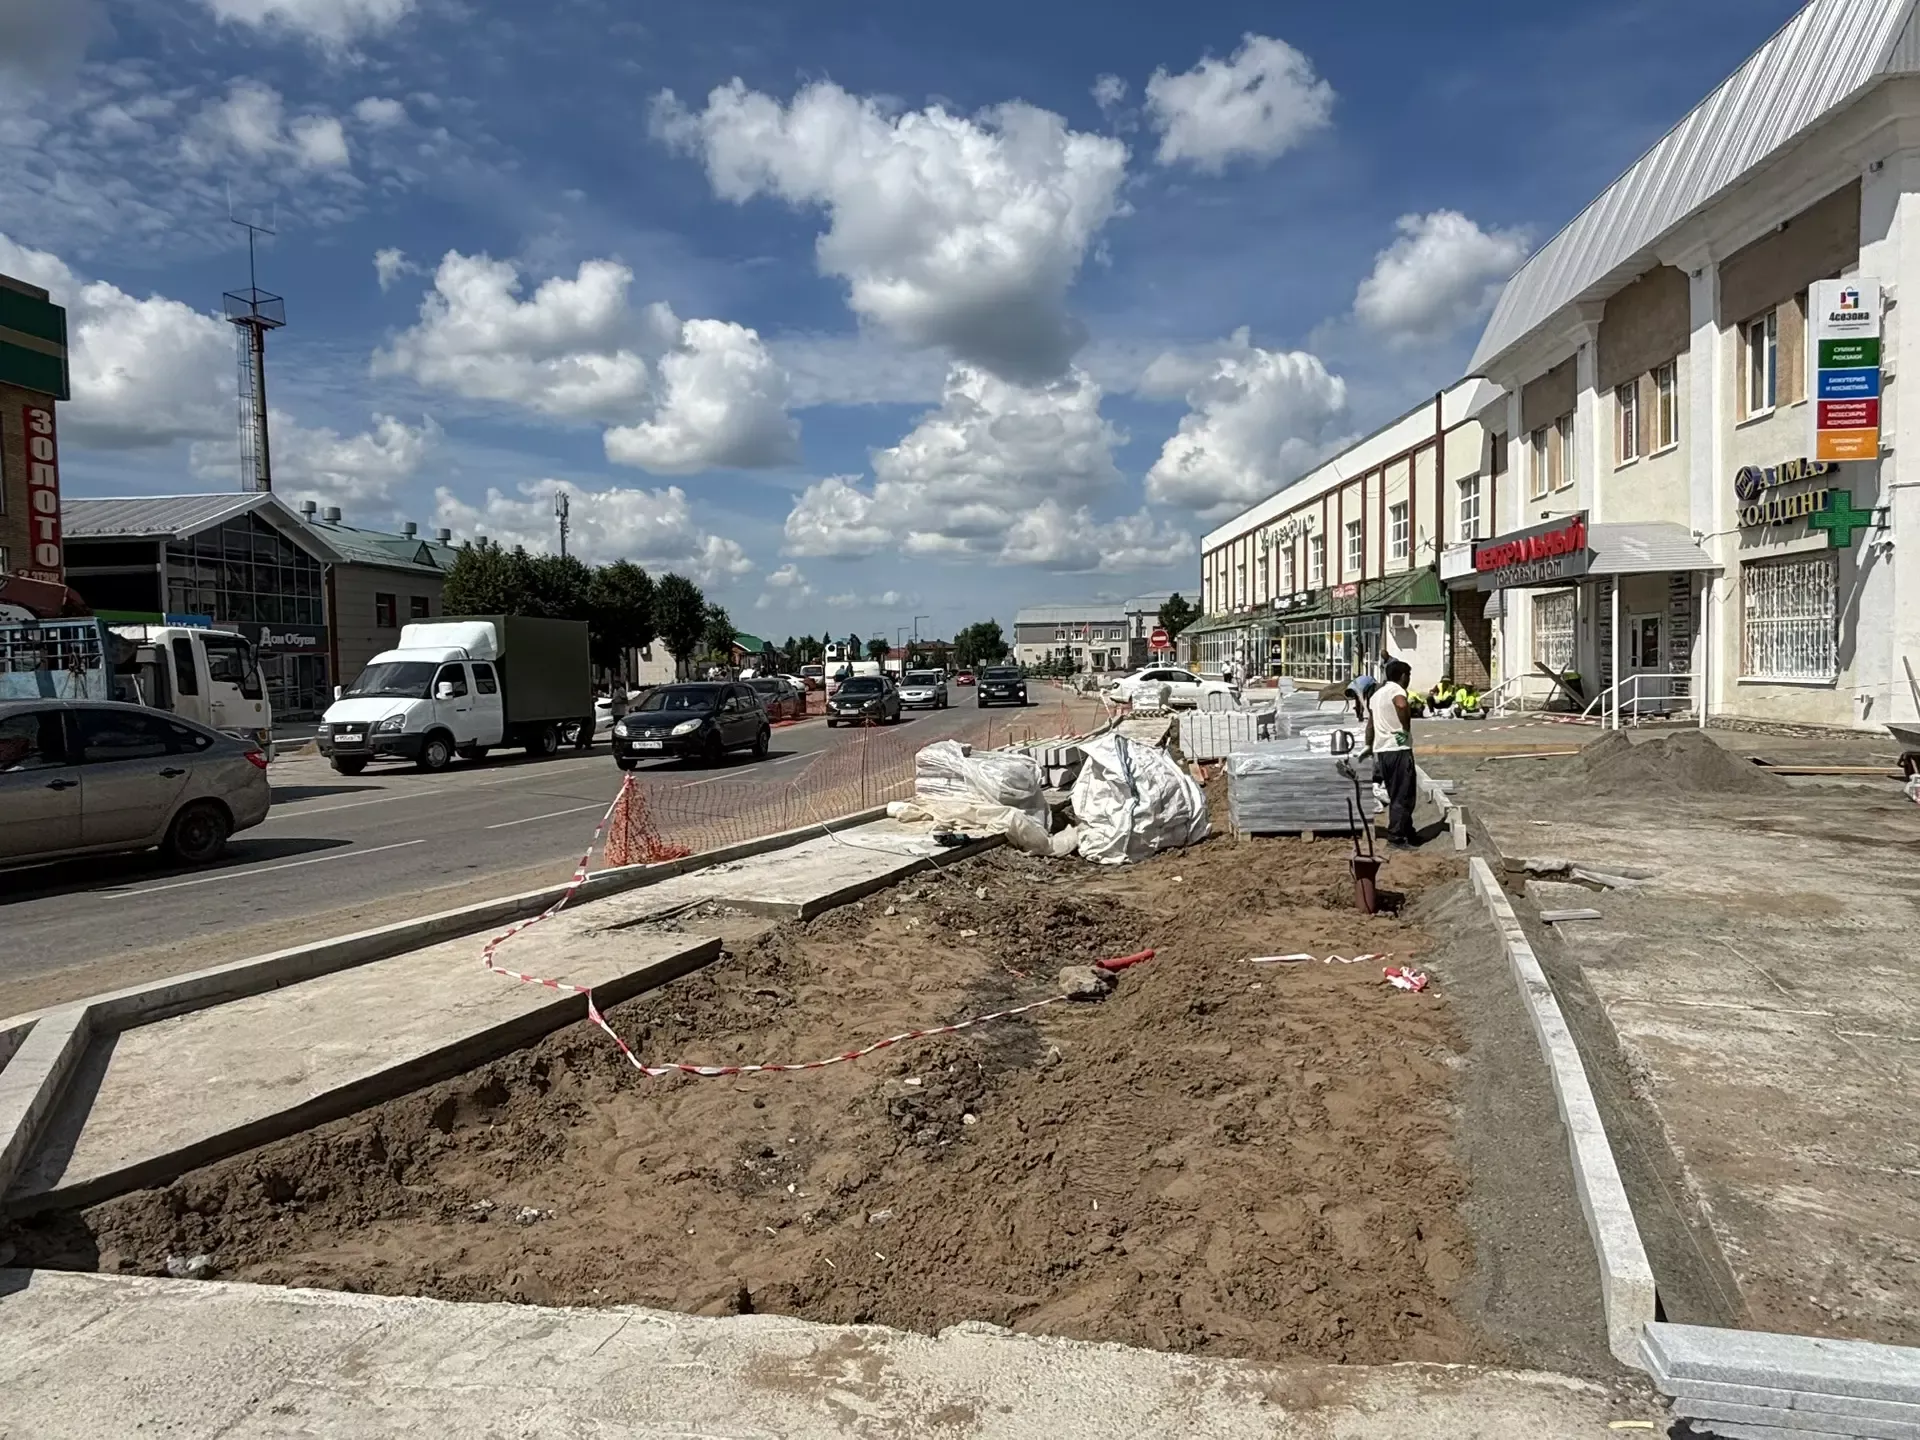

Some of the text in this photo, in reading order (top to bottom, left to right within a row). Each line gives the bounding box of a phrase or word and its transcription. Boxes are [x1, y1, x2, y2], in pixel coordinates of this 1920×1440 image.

[28, 409, 60, 567] ЗОЛОТО
[1475, 516, 1585, 573] ЦЕНТРАЛЬНЫЙ
[1538, 559, 1564, 580] ДОМ
[259, 626, 316, 648] Дом Обуви
